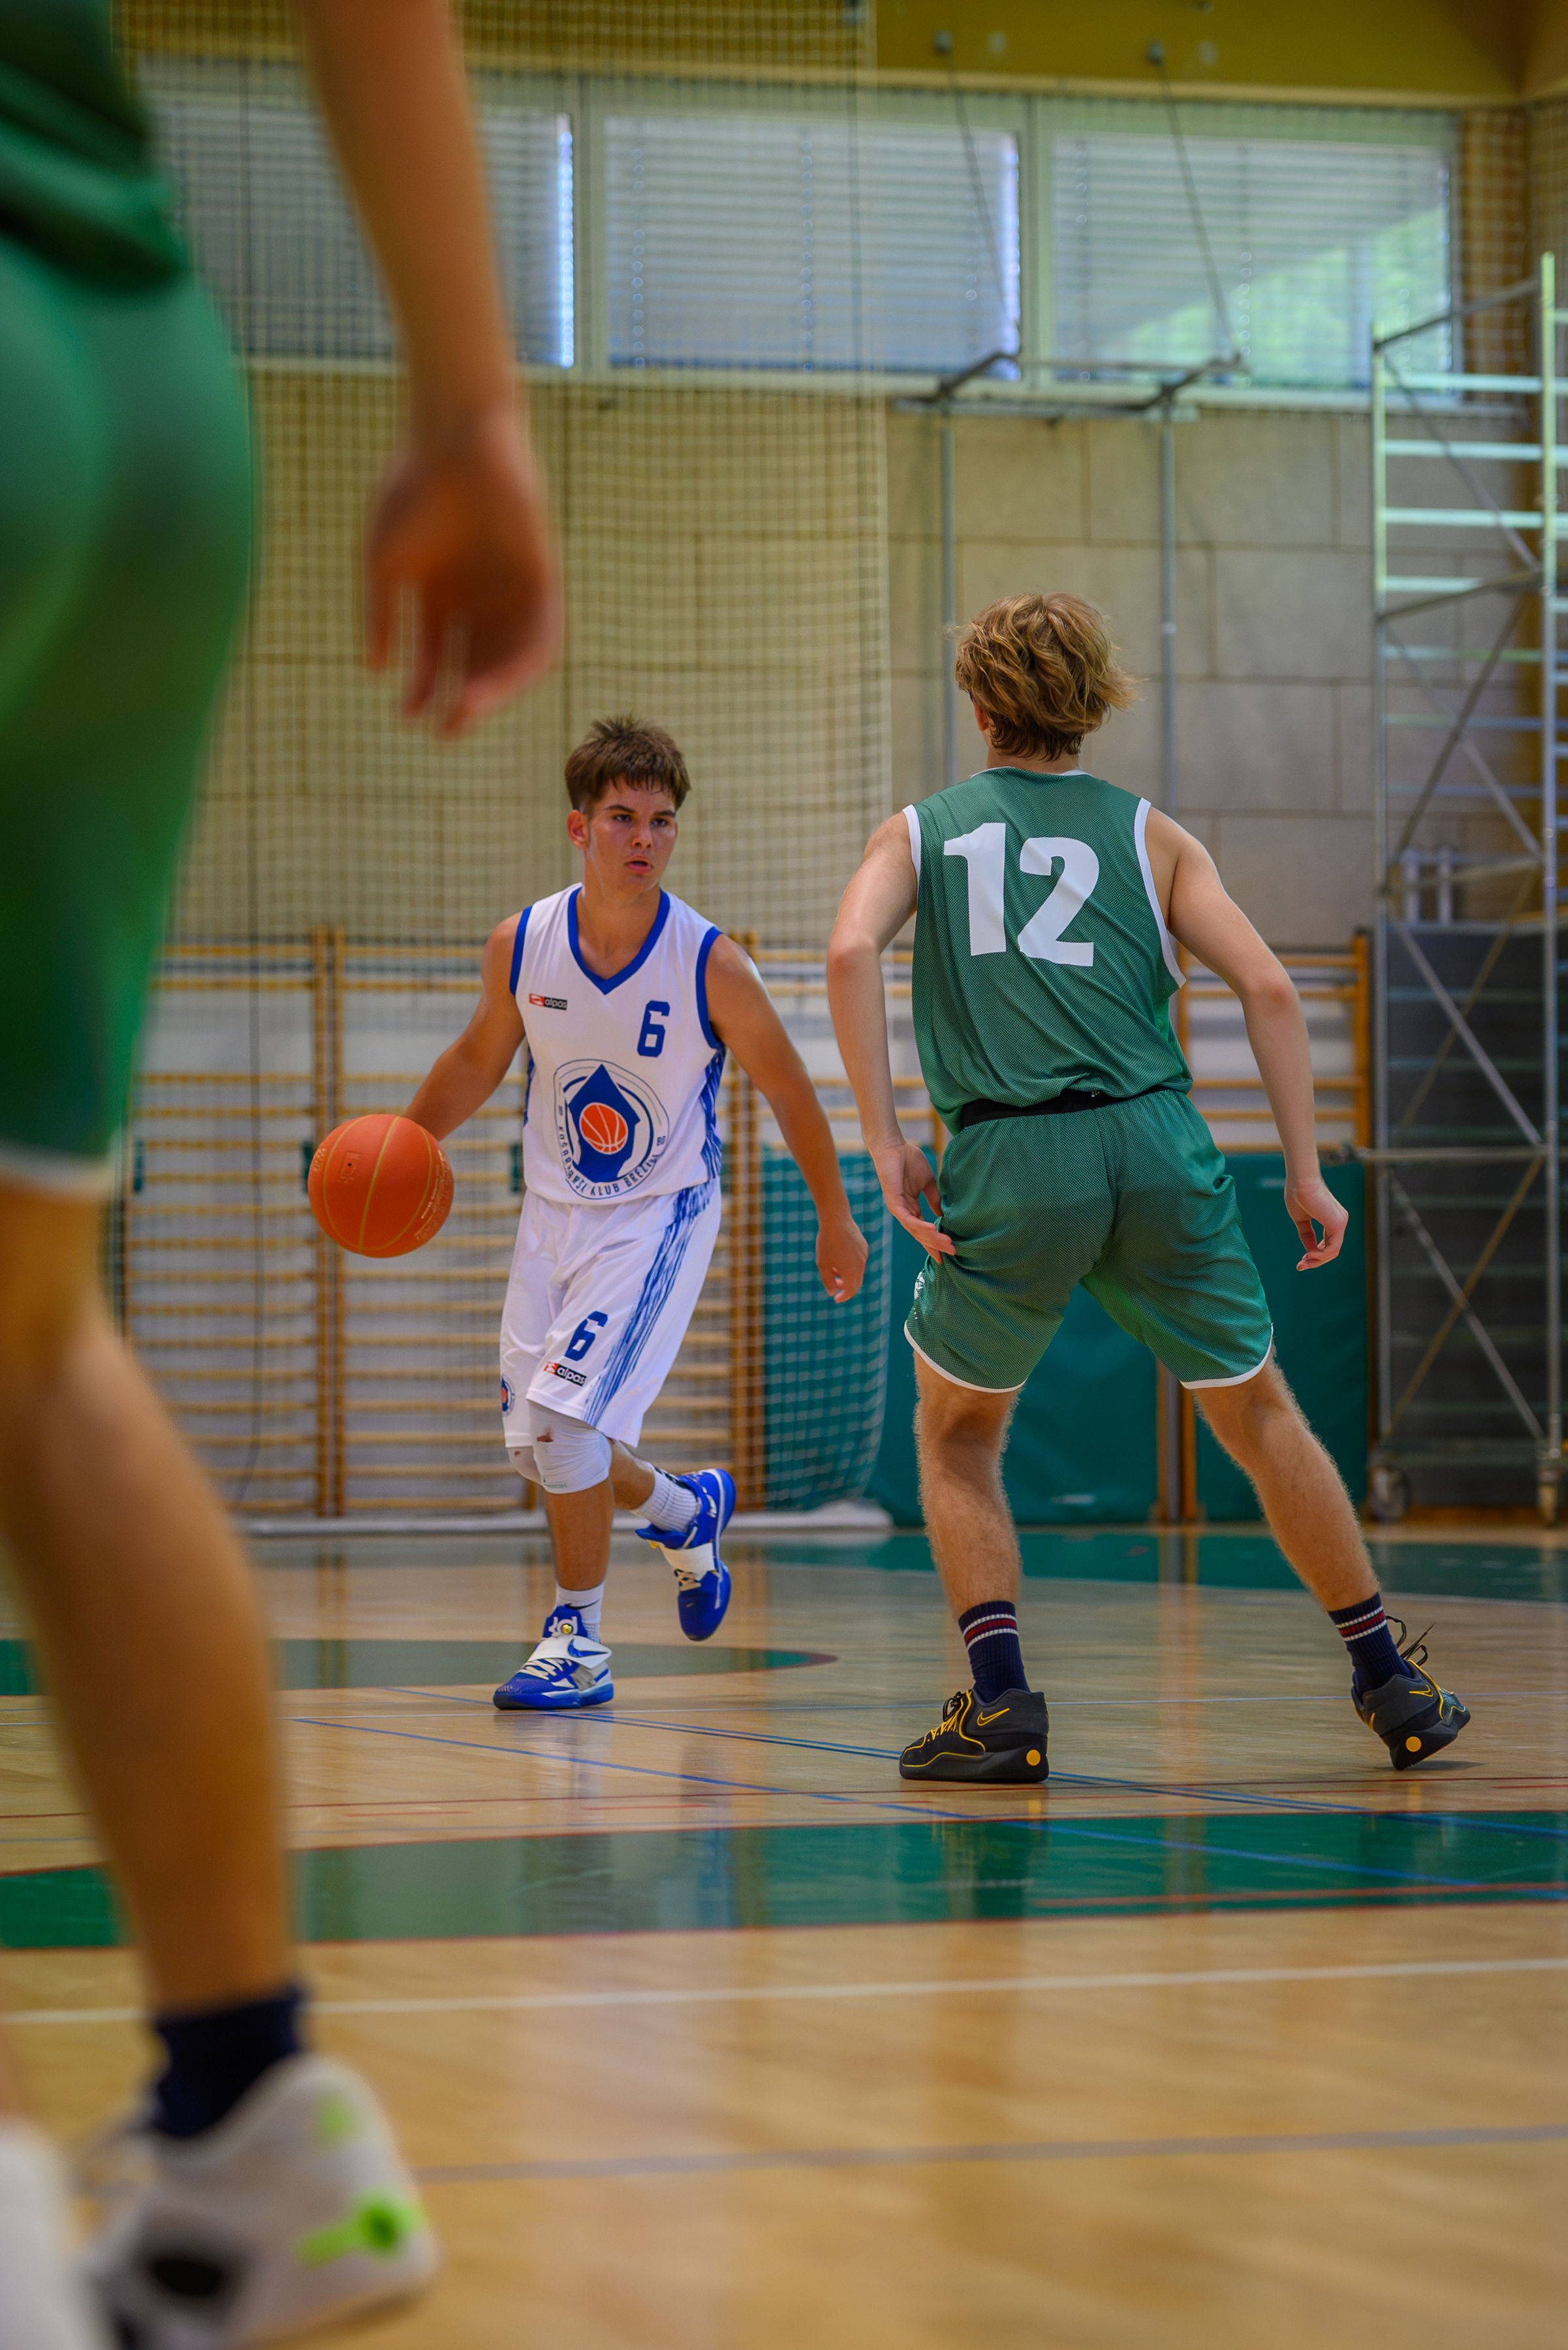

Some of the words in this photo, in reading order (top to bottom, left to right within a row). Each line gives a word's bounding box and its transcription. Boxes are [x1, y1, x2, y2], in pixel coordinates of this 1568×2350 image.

[943, 822, 1100, 967] 12
[637, 1000, 671, 1058] 6
[590, 1183, 620, 1197] KLUB
[563, 1311, 608, 1362] 6
[556, 1367, 586, 1385] alpas
